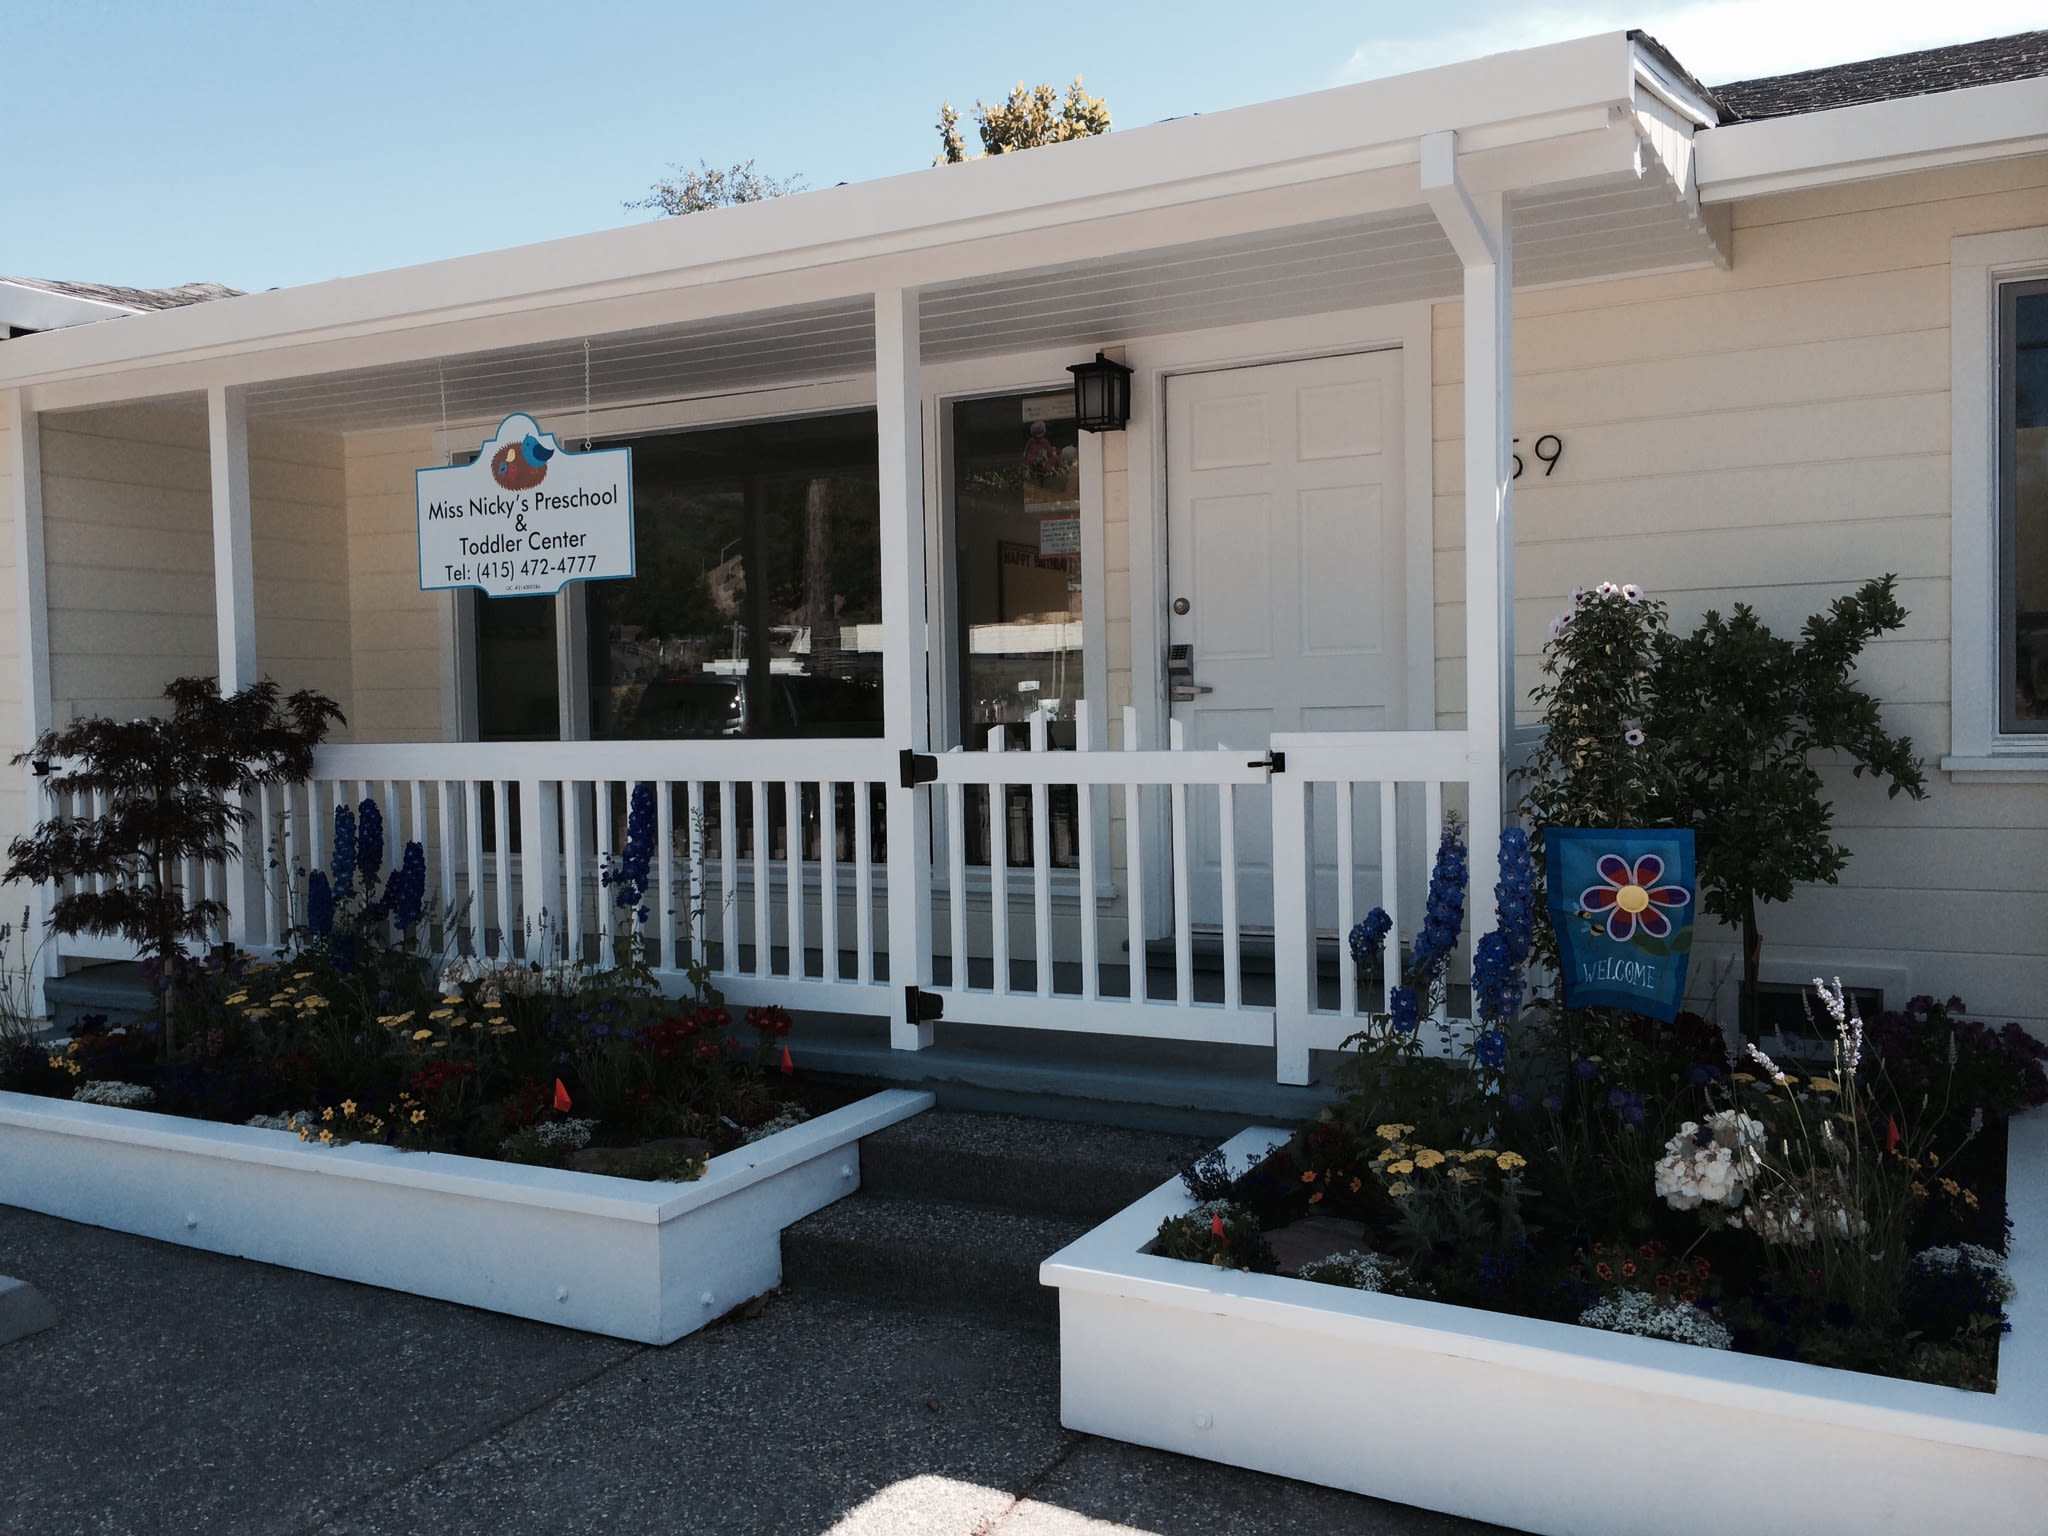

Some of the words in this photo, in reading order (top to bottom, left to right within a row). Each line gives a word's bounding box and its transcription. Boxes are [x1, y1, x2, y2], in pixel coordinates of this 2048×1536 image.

[428, 500, 464, 520] Miss
[469, 493, 529, 519] Nicky's
[535, 483, 618, 511] Preschool
[514, 513, 528, 532] &
[459, 533, 523, 556] Toddler
[527, 531, 587, 550] Center
[445, 563, 471, 582] Tel:
[476, 560, 515, 582] (415)
[520, 554, 597, 576] 472-4777
[1583, 956, 1656, 989] WELCOME
